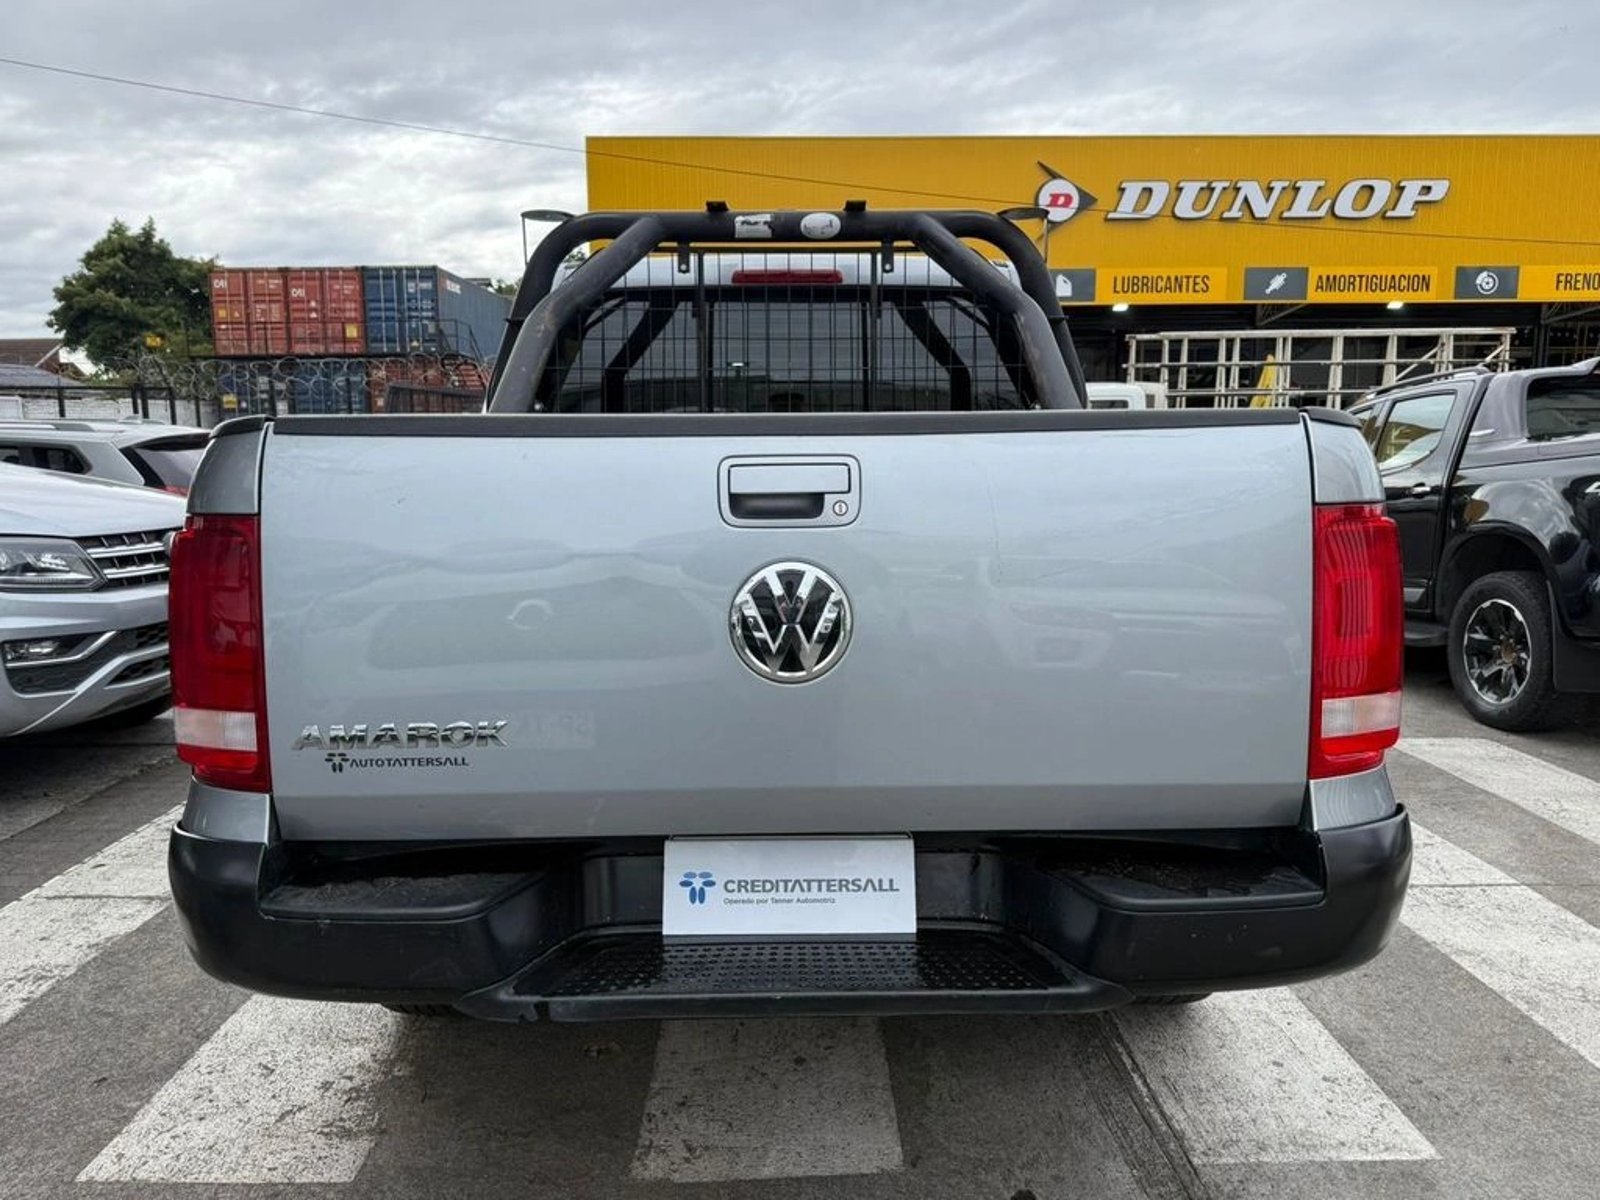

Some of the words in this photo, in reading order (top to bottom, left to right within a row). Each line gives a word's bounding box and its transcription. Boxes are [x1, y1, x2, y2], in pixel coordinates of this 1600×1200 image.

[1104, 179, 1450, 221] DUNLOP
[1113, 275, 1210, 294] LUBRICANTES
[1315, 274, 1431, 293] AMORTIGUACION
[292, 719, 508, 751] AMAROK
[350, 756, 469, 768] AUTOTATTERSALL
[723, 878, 900, 893] CREDITATTERSALL
[723, 897, 754, 906] Operado
